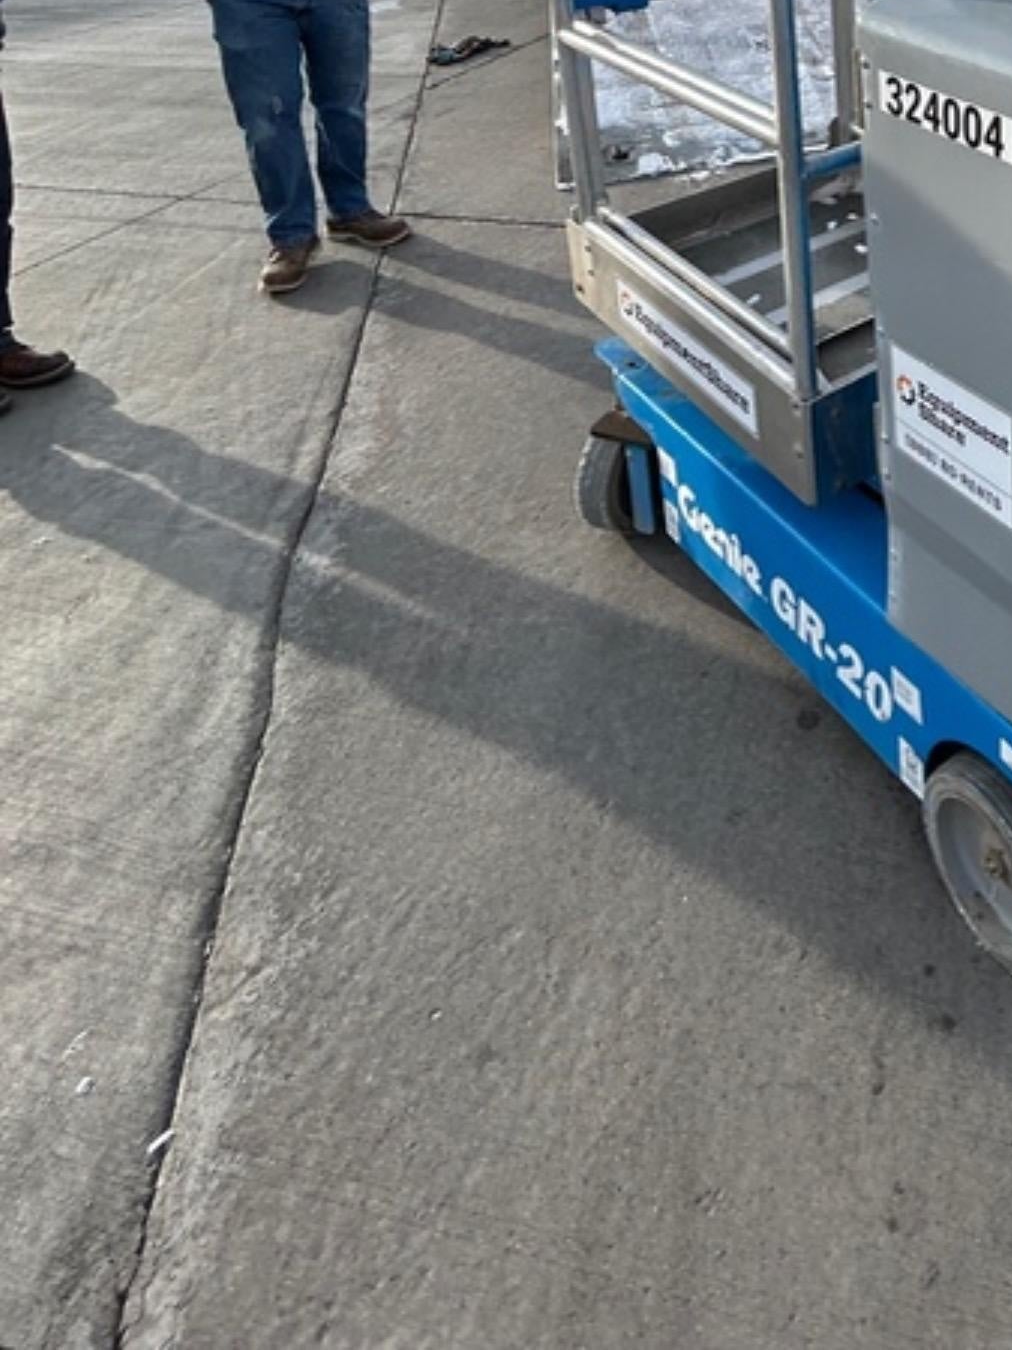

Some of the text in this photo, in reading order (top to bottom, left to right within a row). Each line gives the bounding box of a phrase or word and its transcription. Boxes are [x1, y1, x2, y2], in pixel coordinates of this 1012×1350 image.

[887, 77, 1004, 158] 324004
[917, 380, 1010, 457] Equipment
[917, 402, 967, 448] Share
[677, 484, 894, 722] Genie GR-20
